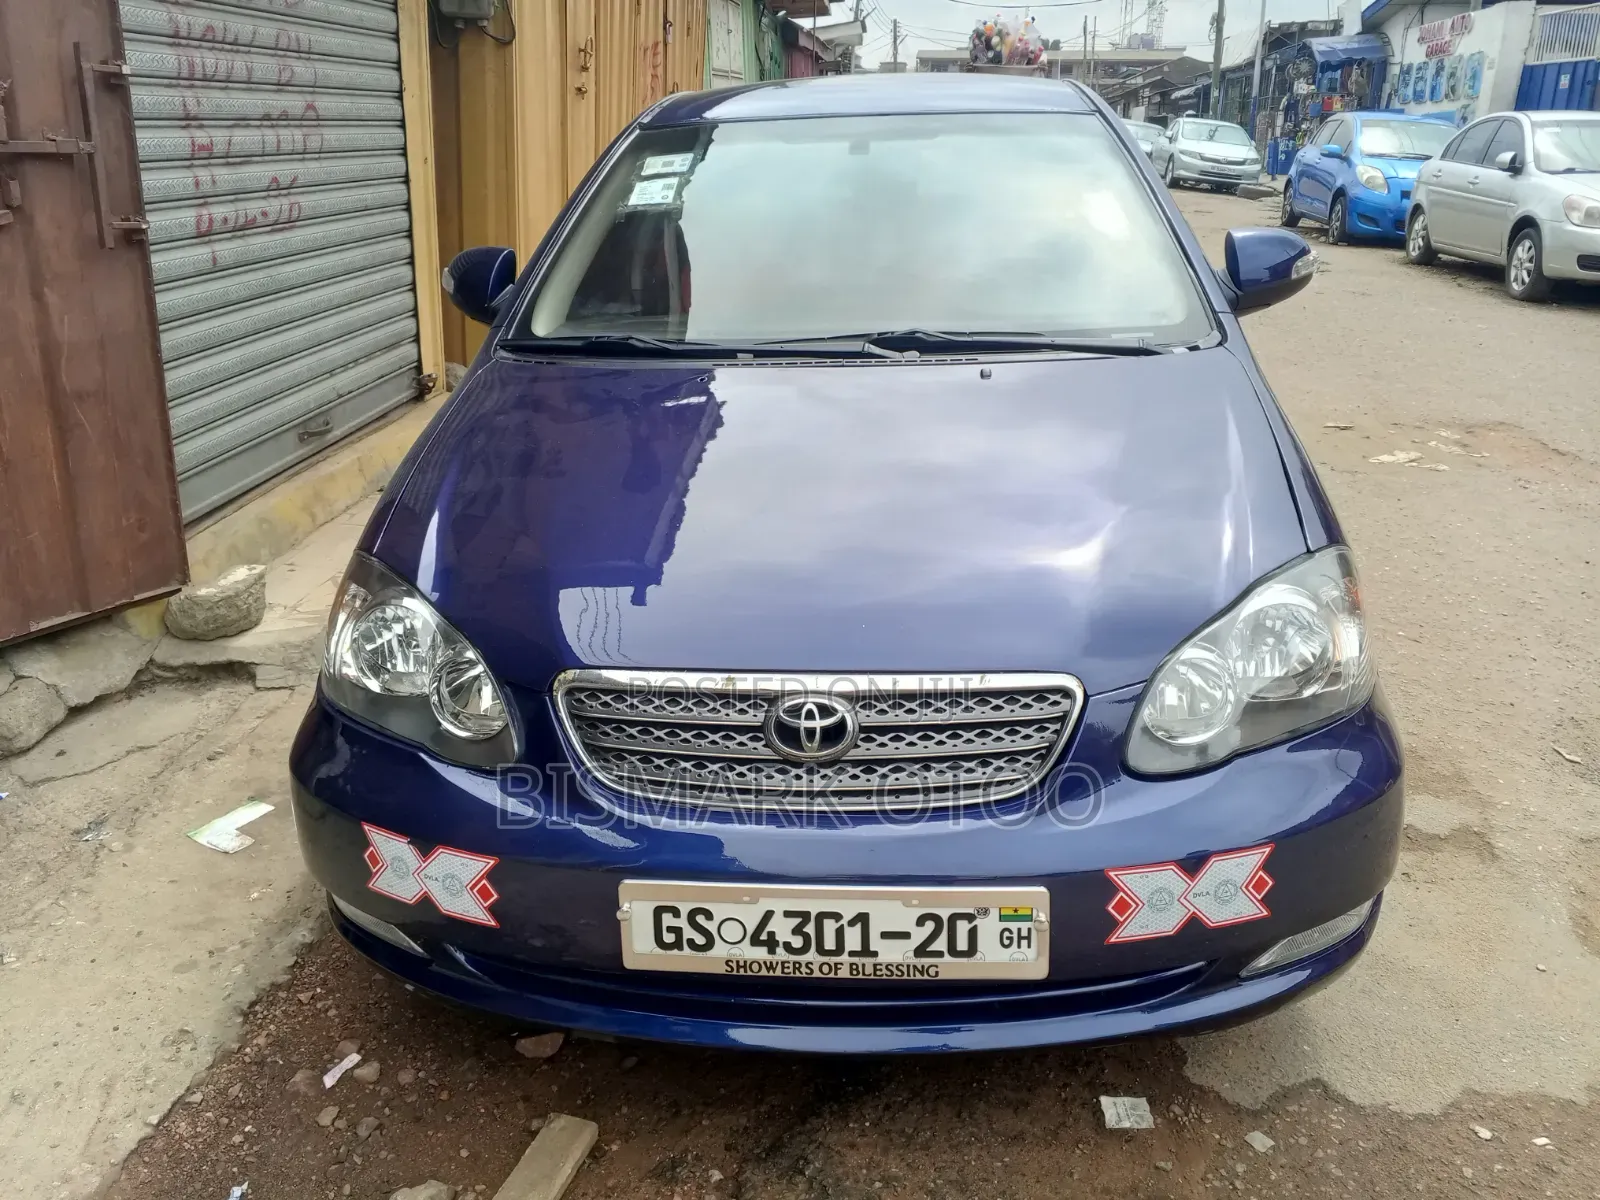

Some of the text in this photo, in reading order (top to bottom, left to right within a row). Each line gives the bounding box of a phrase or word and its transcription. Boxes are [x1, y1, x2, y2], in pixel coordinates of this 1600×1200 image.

[1426, 39, 1453, 59] GARAGE
[1192, 891, 1211, 899] DVLA
[653, 905, 978, 959] GS 4301-20
[999, 927, 1033, 949] GH
[724, 959, 940, 979] SHOWERS OF BLESSING
